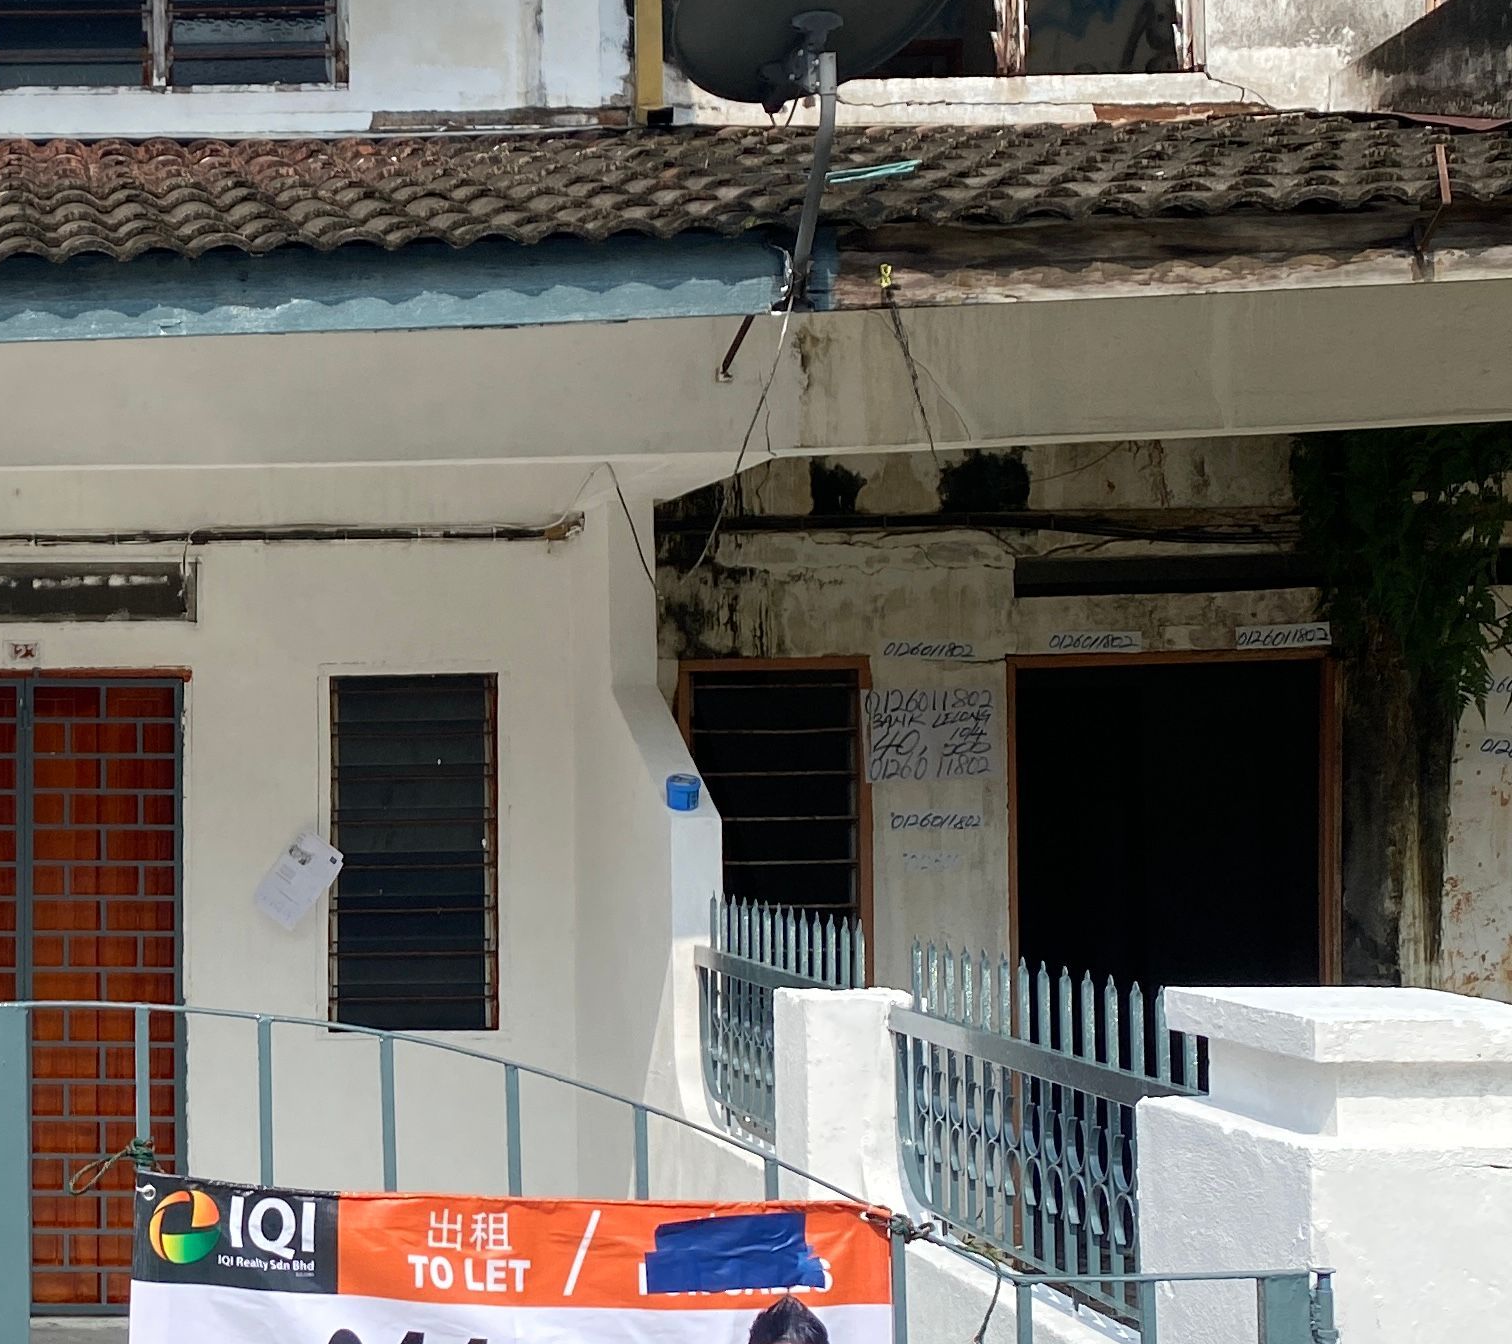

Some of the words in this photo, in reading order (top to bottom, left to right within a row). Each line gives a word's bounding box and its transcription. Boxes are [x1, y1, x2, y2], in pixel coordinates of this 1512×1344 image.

[1238, 627, 1329, 646] 0126011802
[865, 689, 994, 714] 0126011802
[1480, 738, 1512, 758] 012
[229, 1195, 316, 1260] IQI
[428, 1207, 513, 1253] 出租
[217, 1254, 234, 1267] IQI
[235, 1256, 268, 1272] Realty
[269, 1259, 291, 1271] Sdn
[292, 1260, 315, 1272] Bhd
[407, 1255, 454, 1290] TO
[463, 1257, 531, 1293] LET
